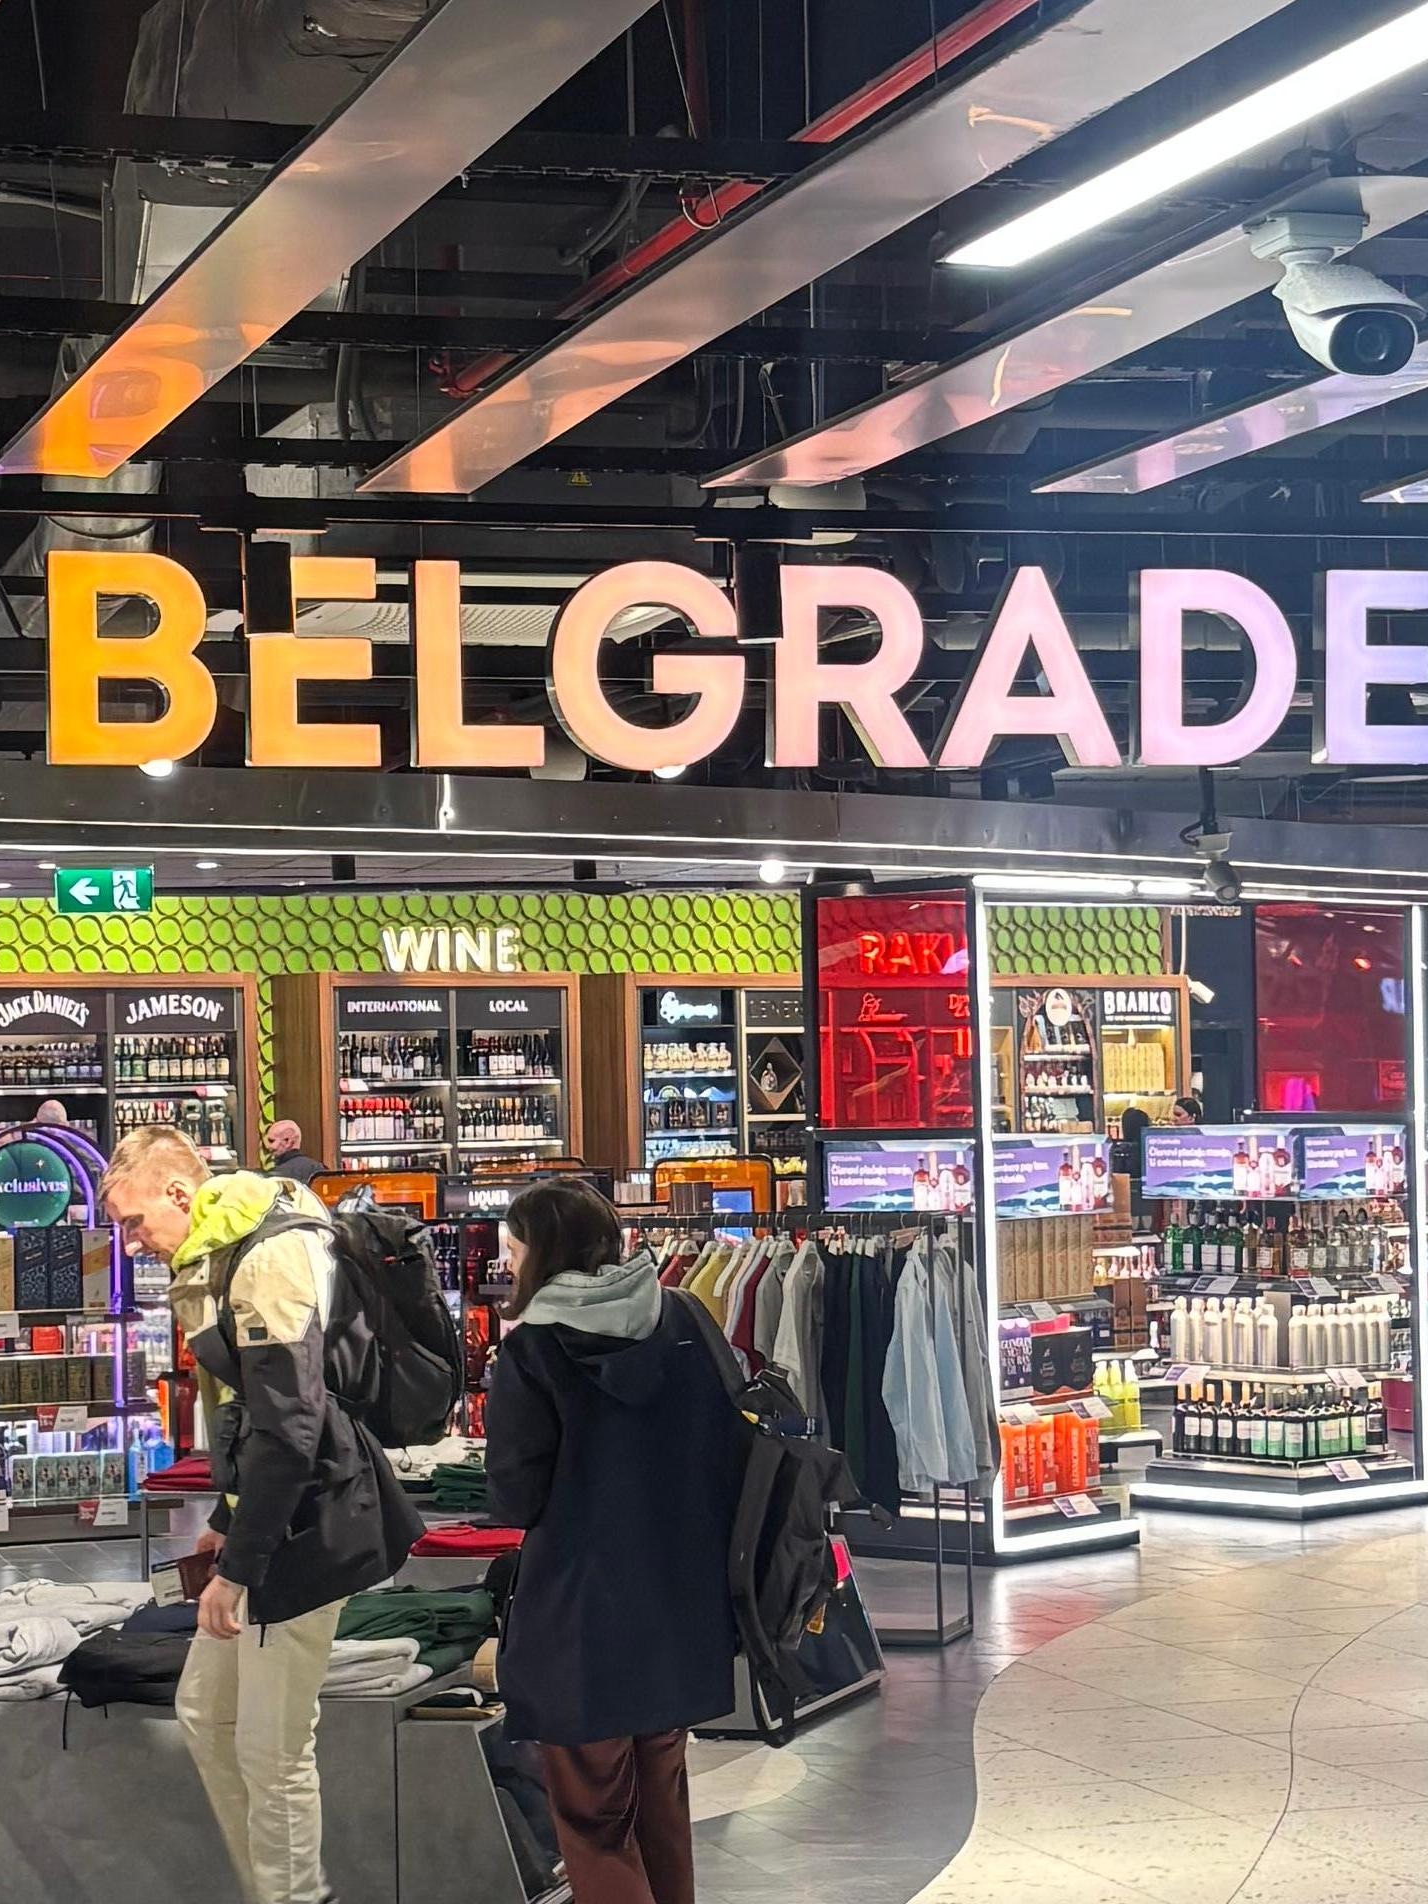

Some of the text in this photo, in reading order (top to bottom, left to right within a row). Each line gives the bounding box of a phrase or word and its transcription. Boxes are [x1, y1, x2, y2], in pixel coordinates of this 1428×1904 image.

[382, 926, 520, 973] WINE
[33, 990, 90, 1028] DANIEL'S
[125, 995, 222, 1024] JAMESON
[347, 1000, 442, 1013] INTERNATIONAL
[489, 1000, 528, 1013] LOCAL
[1103, 991, 1171, 1015] BRANKO
